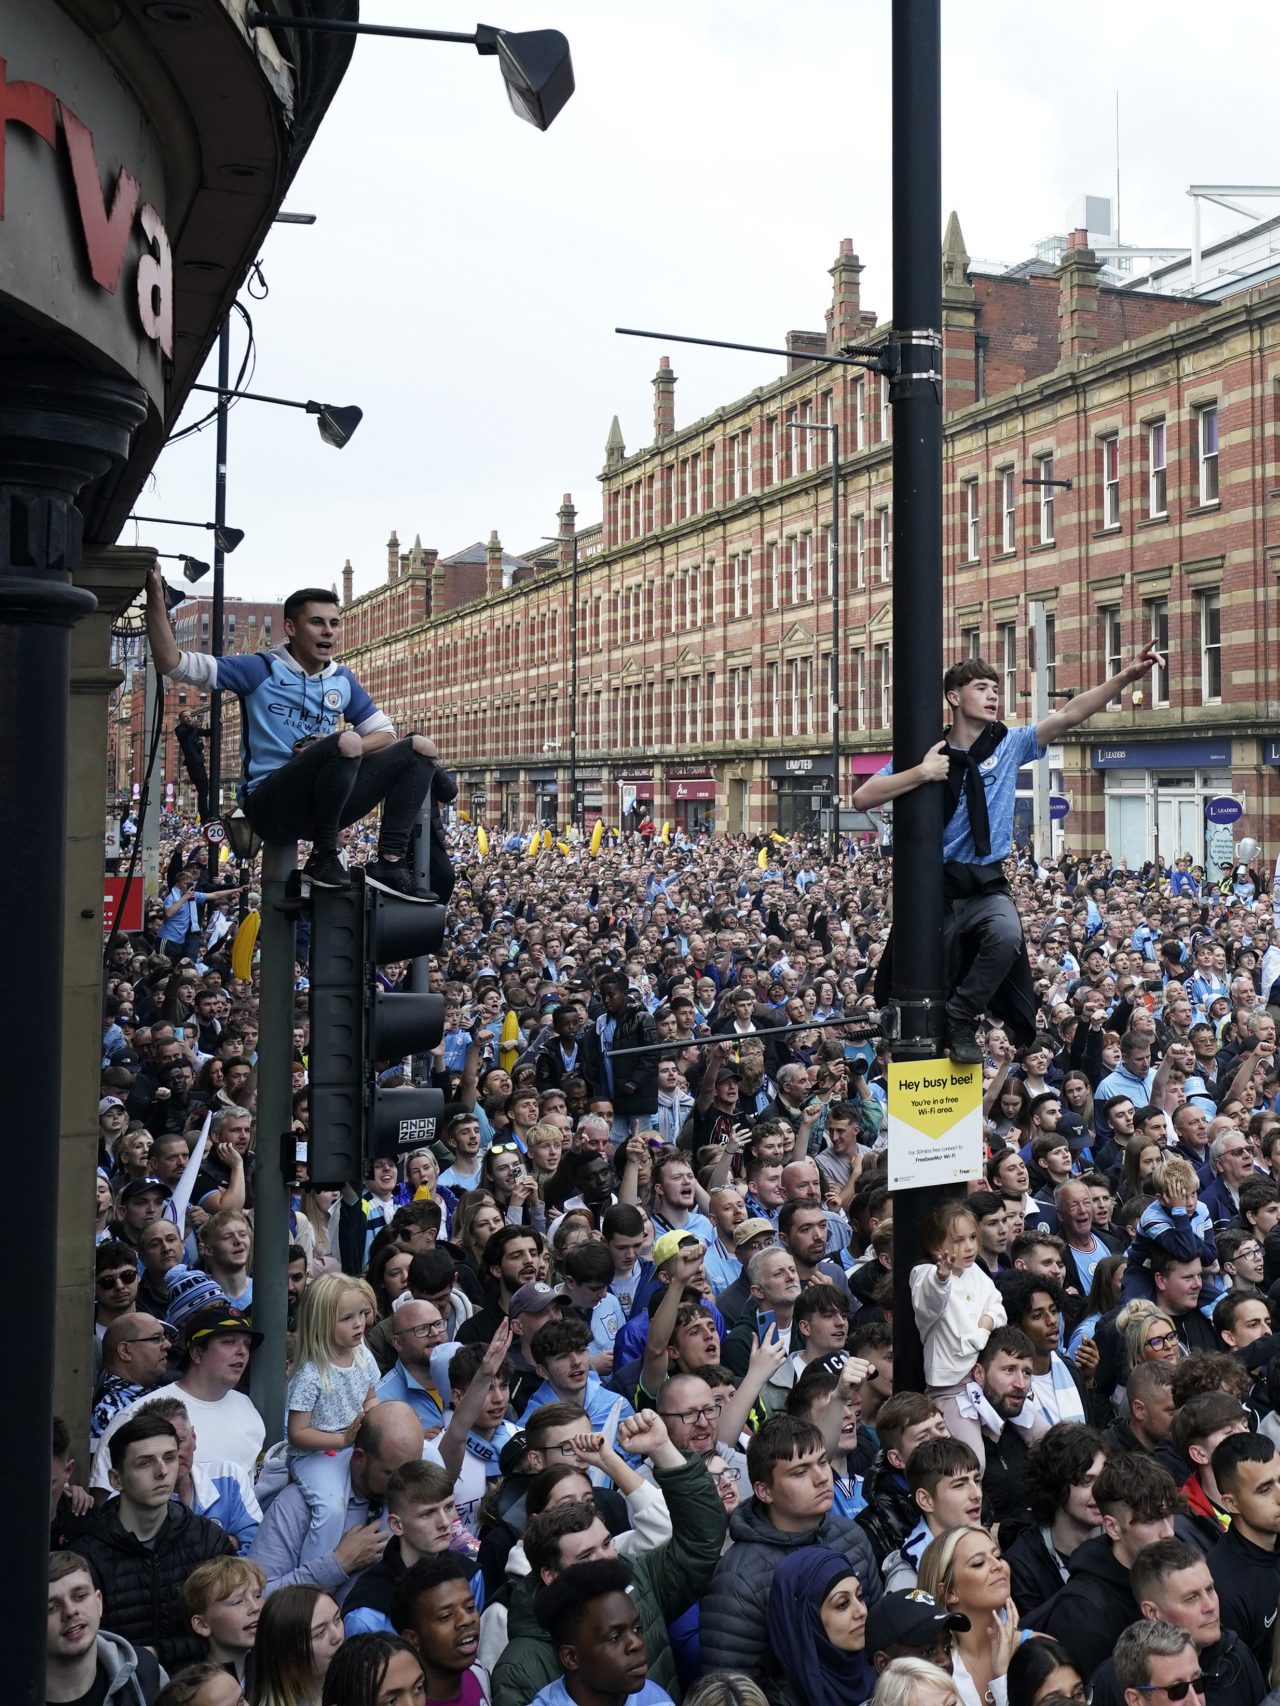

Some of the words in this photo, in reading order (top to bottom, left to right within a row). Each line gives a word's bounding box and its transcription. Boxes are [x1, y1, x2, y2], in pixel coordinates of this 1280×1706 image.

[267, 703, 338, 726] ETIHAD
[283, 719, 331, 734] AIRWAYS
[1106, 751, 1126, 759] LEADERS
[209, 828, 224, 838] 20
[899, 1079, 920, 1092] Hey
[923, 1077, 948, 1090] busy
[950, 1073, 973, 1086] bee!
[911, 1099, 932, 1107] You're
[918, 1107, 936, 1115] Wi-Fi
[401, 1118, 435, 1131] ANON
[400, 1129, 434, 1140] ZEDS
